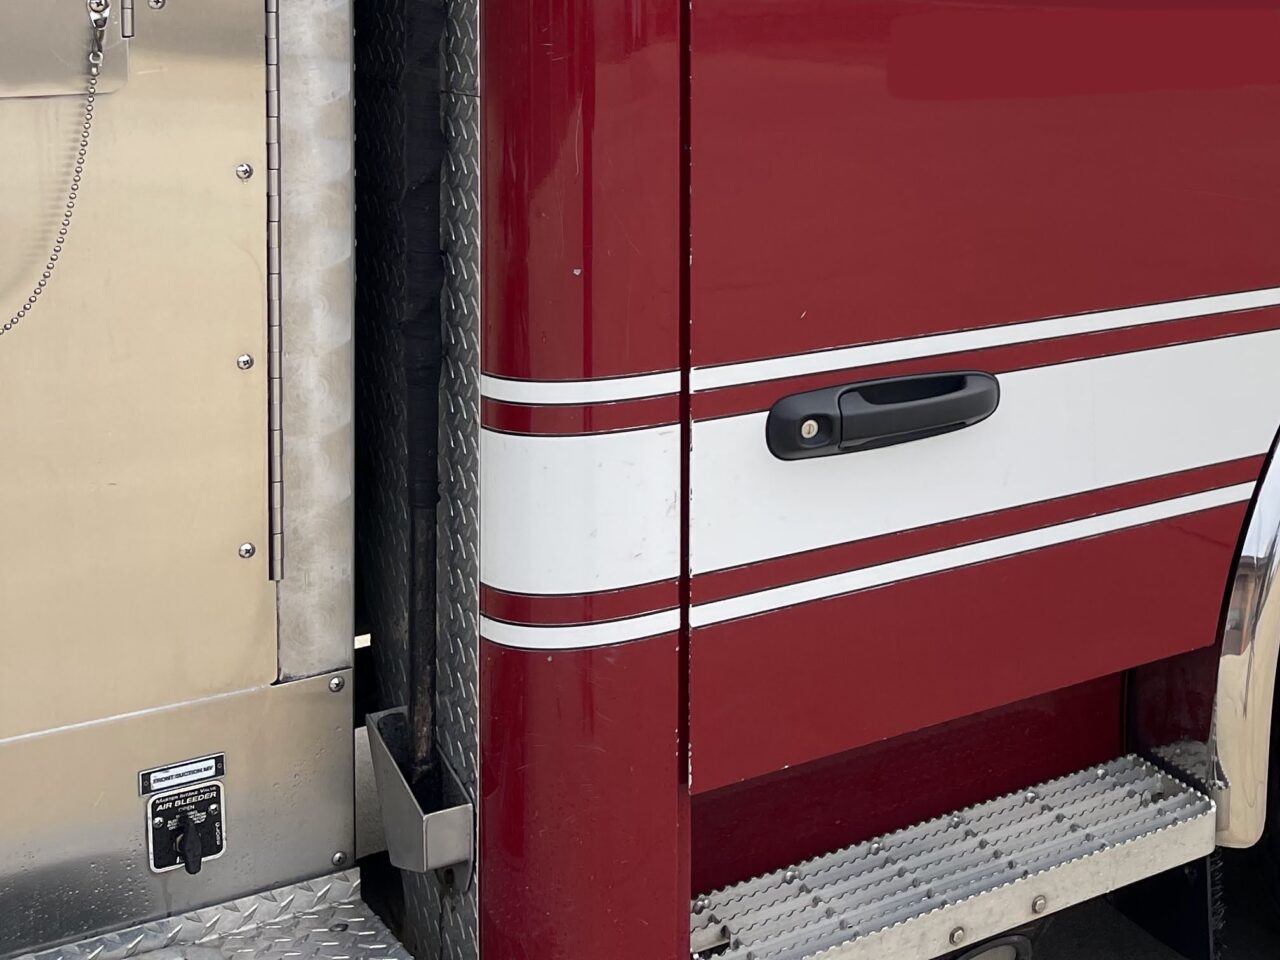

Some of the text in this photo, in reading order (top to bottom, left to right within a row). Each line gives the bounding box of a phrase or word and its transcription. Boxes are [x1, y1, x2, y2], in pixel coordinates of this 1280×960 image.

[153, 775, 175, 784] FRONT
[156, 791, 217, 812] AIR BLEEDER
